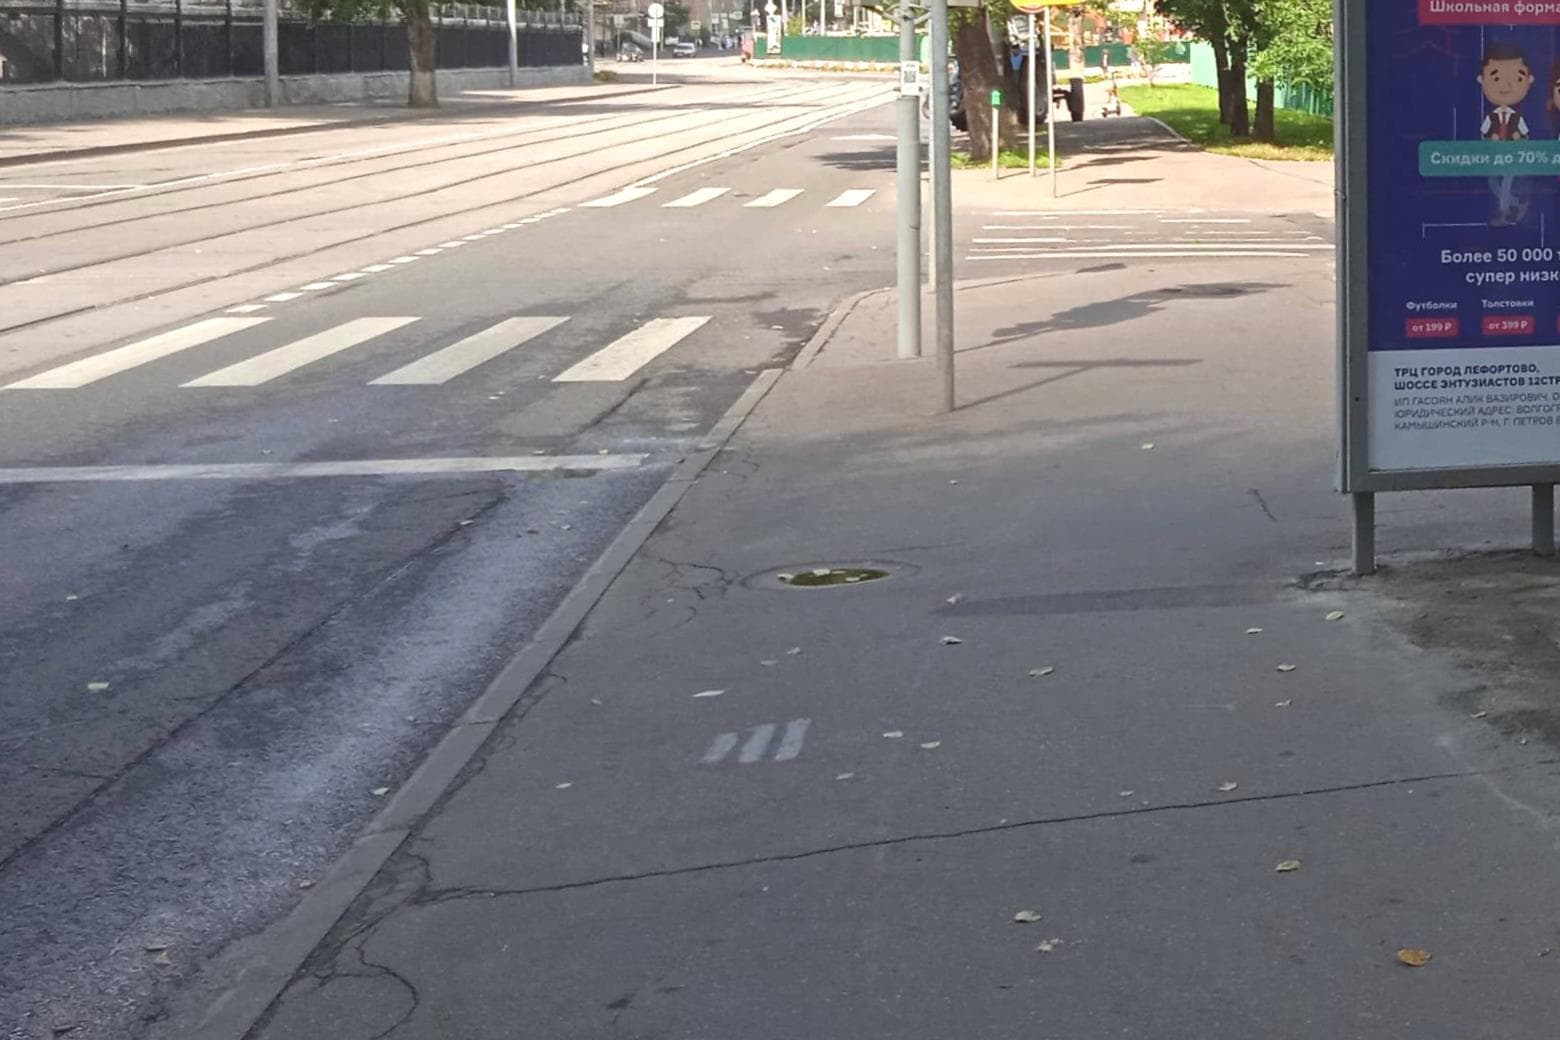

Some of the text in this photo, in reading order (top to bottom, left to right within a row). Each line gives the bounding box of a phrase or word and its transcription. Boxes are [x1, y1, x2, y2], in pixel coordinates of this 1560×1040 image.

[1429, 0, 1510, 12] Школьная
[1430, 151, 1489, 166] Скидки
[1493, 154, 1513, 166] до
[1518, 151, 1547, 164] 70%
[1441, 249, 1492, 264] Более
[1497, 248, 1517, 262] 50
[1522, 248, 1553, 262] 000
[1465, 271, 1515, 286] супер
[1406, 301, 1457, 311] Футболки
[1481, 299, 1534, 309] Толстовки
[1412, 324, 1423, 332] от
[1394, 364, 1540, 378] ТРЦ ГОРОД ЛЕФОРТОВО,
[1394, 380, 1438, 390] ШОССЕ
[1441, 377, 1525, 389] ЭНТУЗИАСТОВ
[1394, 406, 1478, 418] ЮРИДИЧЕСКИЙ
[1394, 419, 1479, 430] КАМЫШИНСКИЙ
[1513, 416, 1553, 426] ПЕТРОВ
